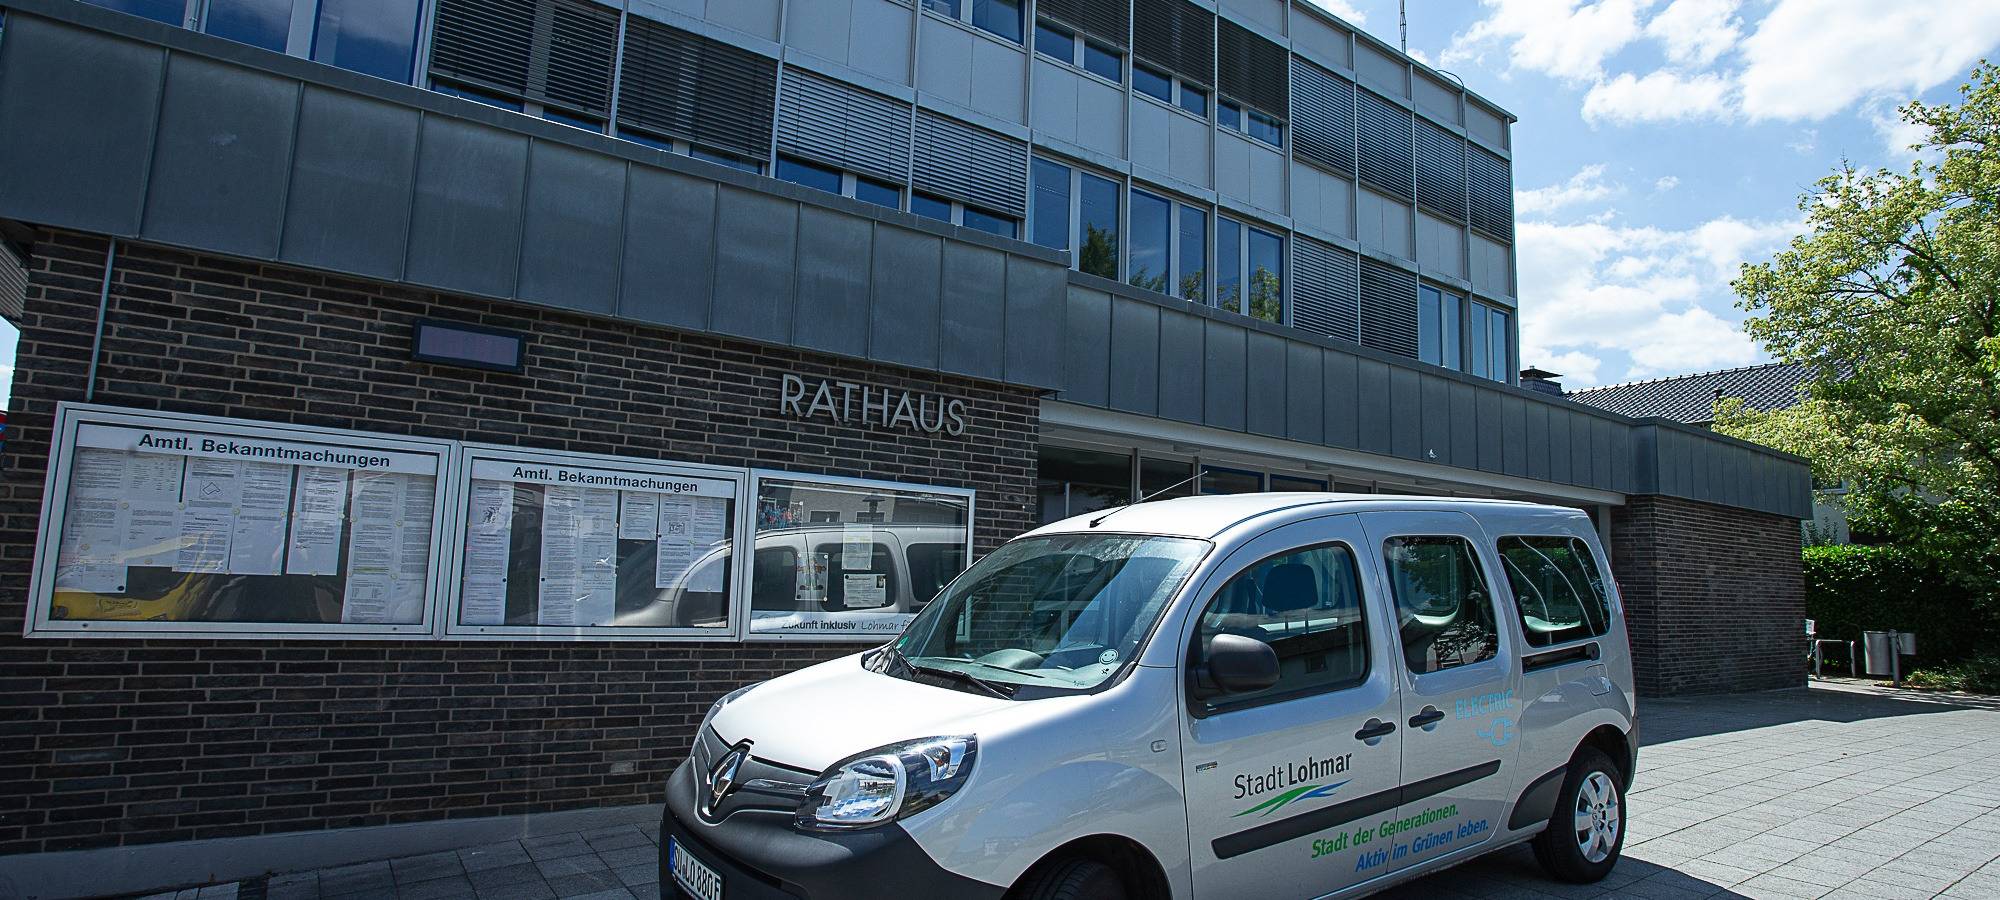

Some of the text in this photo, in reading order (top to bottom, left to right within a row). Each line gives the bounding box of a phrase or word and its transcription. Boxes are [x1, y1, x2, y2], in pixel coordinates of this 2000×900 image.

[780, 373, 965, 437] RATHAUS
[139, 433, 391, 468] Amtl. Bekanntmachungen
[512, 466, 699, 493] Amtl. Bekanntmachungen
[820, 620, 857, 630] inklusiv
[861, 621, 899, 631] Lohmar
[1455, 688, 1513, 720] ELECTRIC
[1233, 752, 1352, 799] Stadt Lohmar
[1311, 804, 1459, 859] Stadt der Generationen.
[1355, 818, 1489, 873] Aktiv im Grünen leben.
